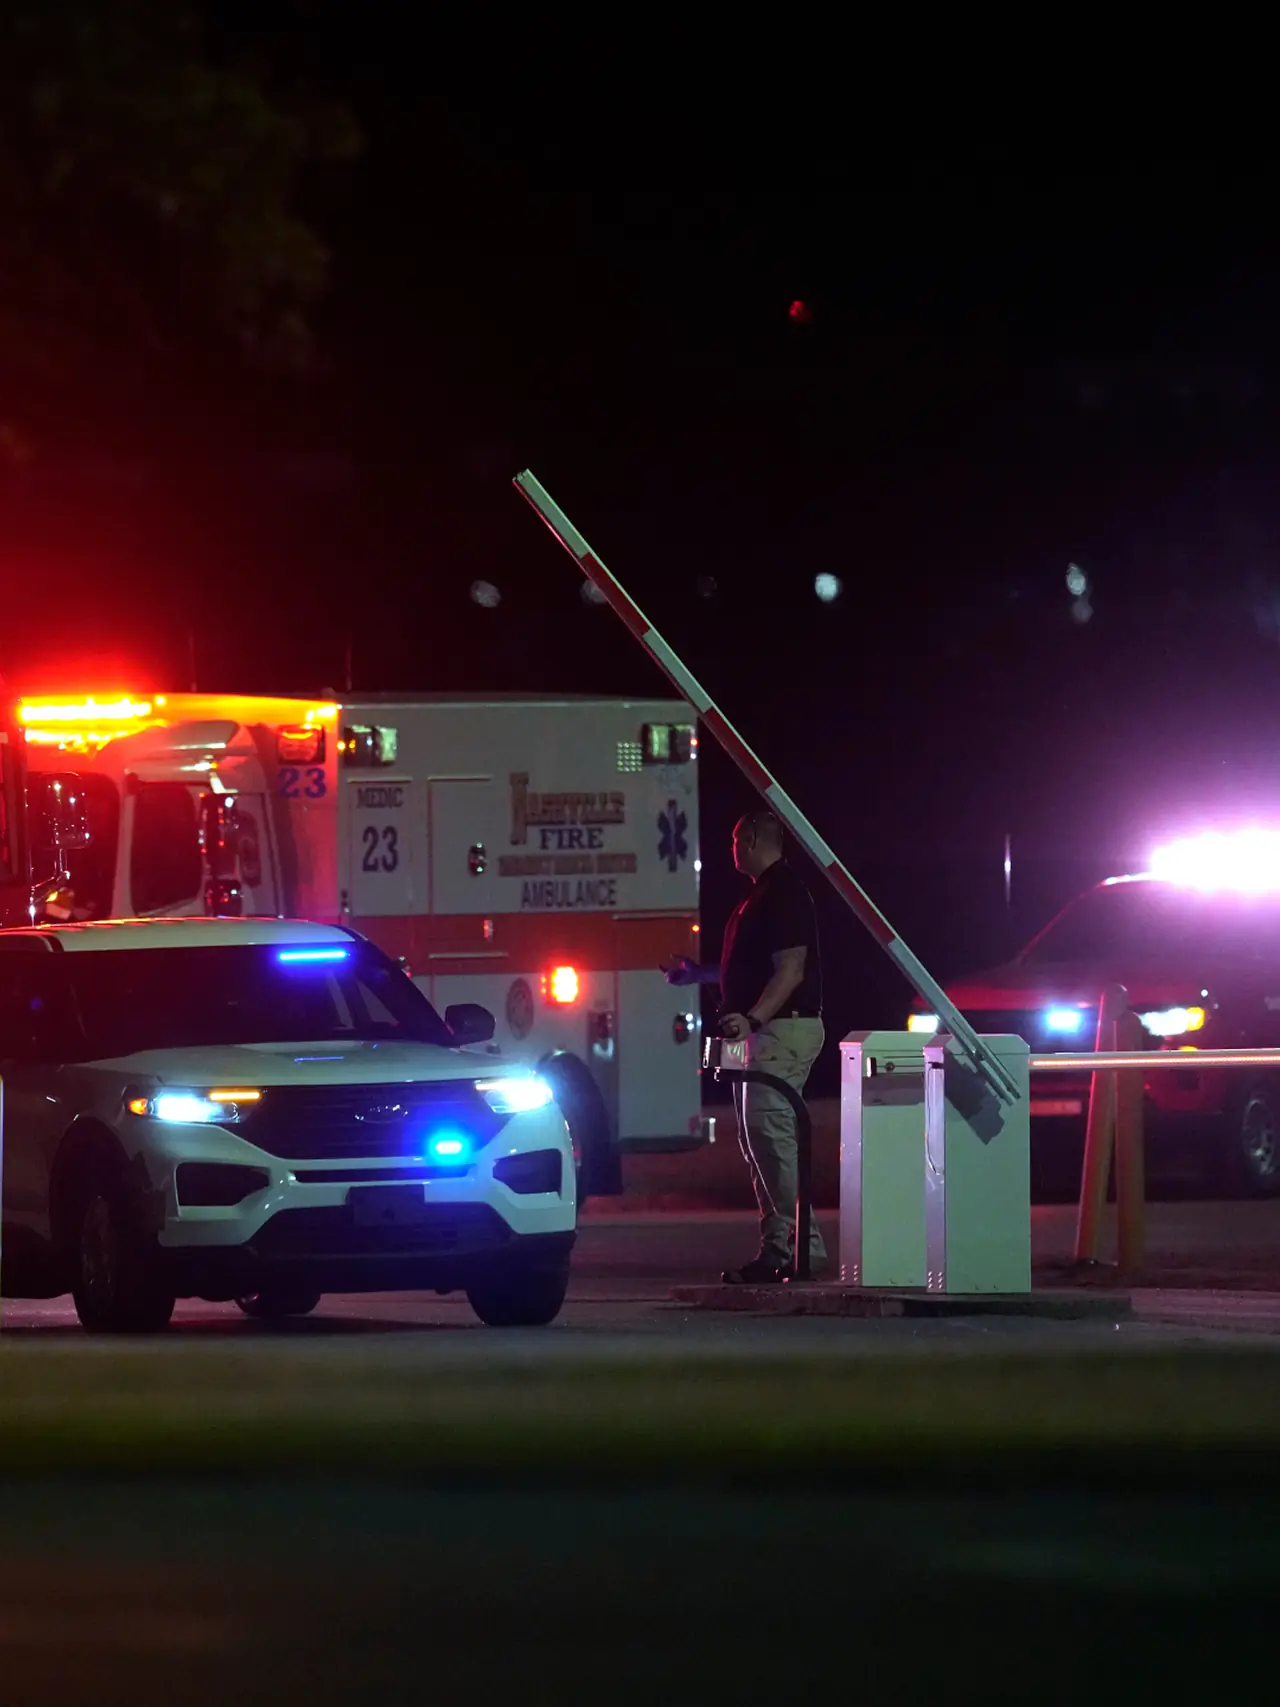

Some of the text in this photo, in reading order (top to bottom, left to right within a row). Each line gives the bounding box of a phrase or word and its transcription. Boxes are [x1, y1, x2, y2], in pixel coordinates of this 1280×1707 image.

[277, 767, 327, 799] 23
[357, 787, 404, 809] MEDIC
[362, 826, 399, 872] 23
[539, 827, 604, 850] FIRE
[521, 879, 617, 909] AMBULANCE
